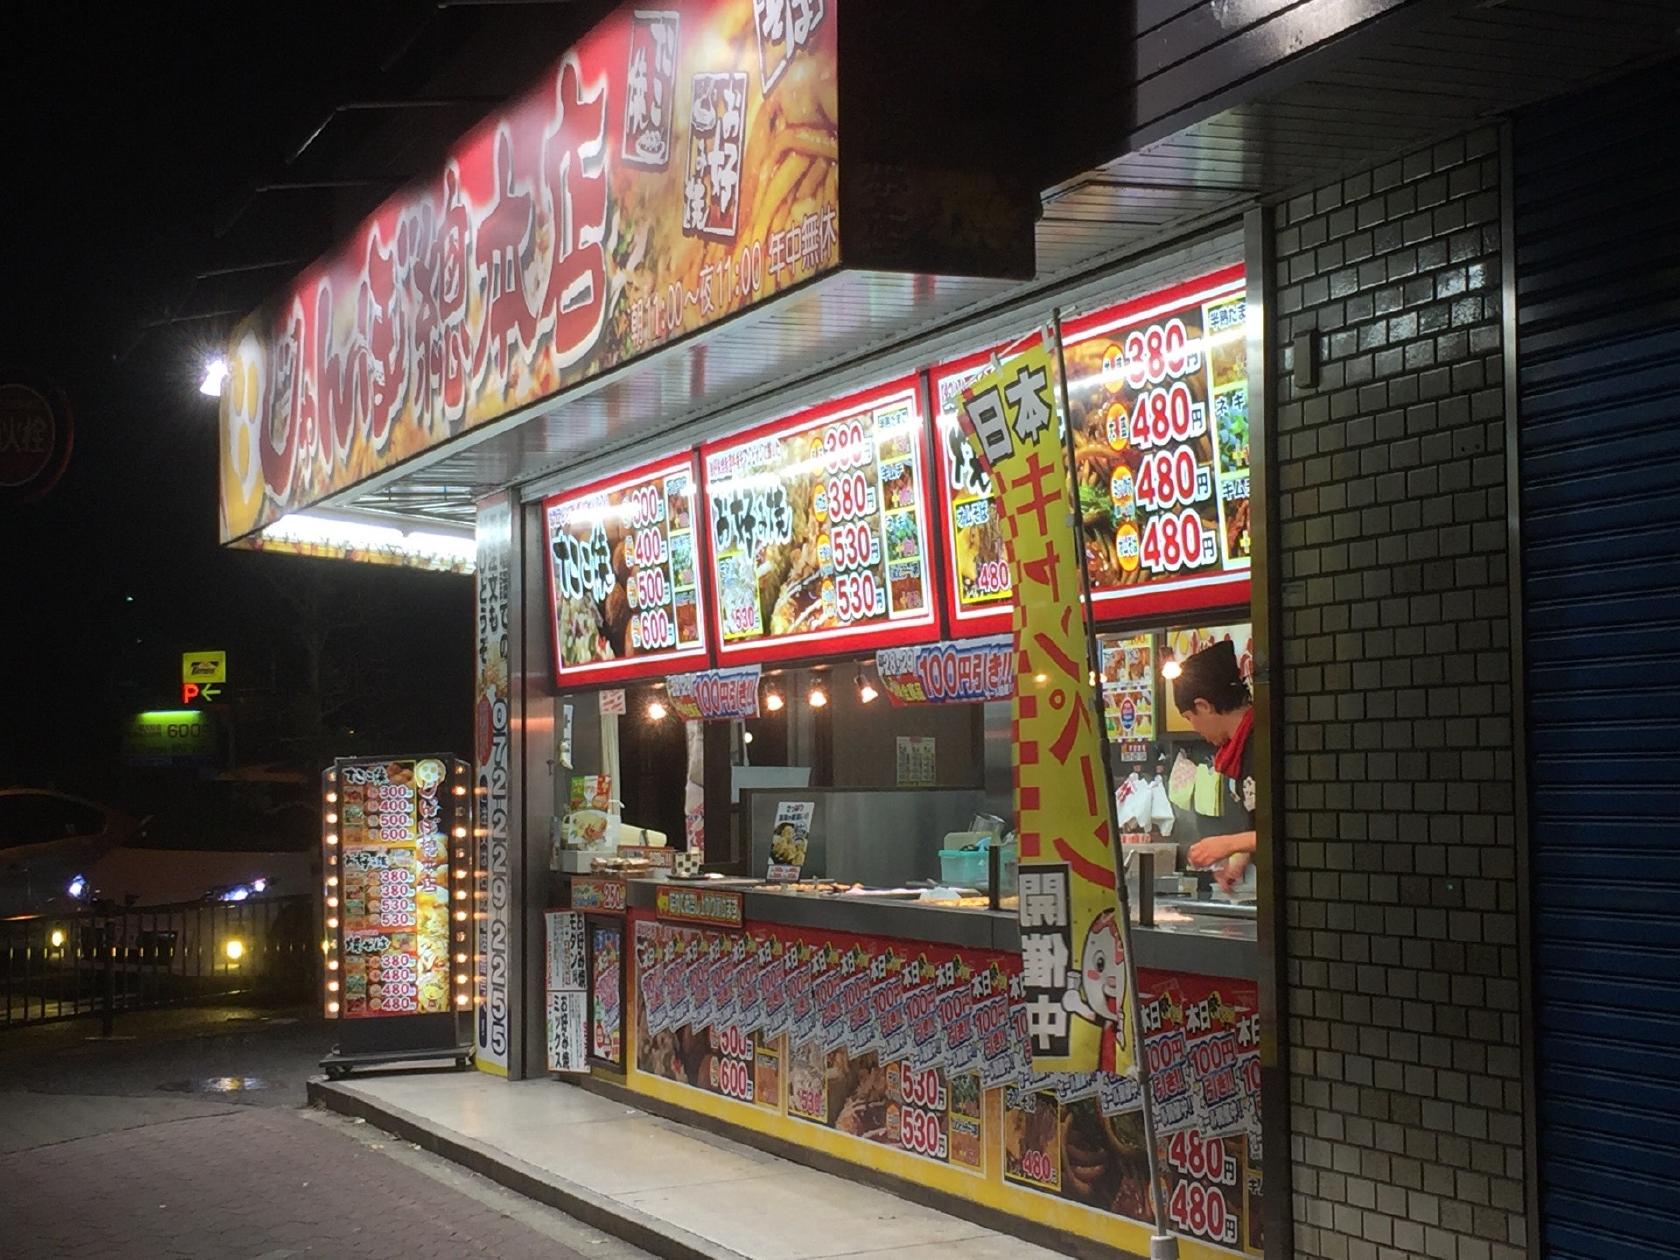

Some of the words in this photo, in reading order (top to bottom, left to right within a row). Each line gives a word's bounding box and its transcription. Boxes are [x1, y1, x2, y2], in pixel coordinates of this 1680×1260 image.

[768, 205, 837, 283] 年中無休
[1132, 388, 1203, 443] 480円
[1137, 450, 1209, 507] 480円
[1144, 514, 1215, 567] 480円
[1171, 1182, 1237, 1241] 480円
